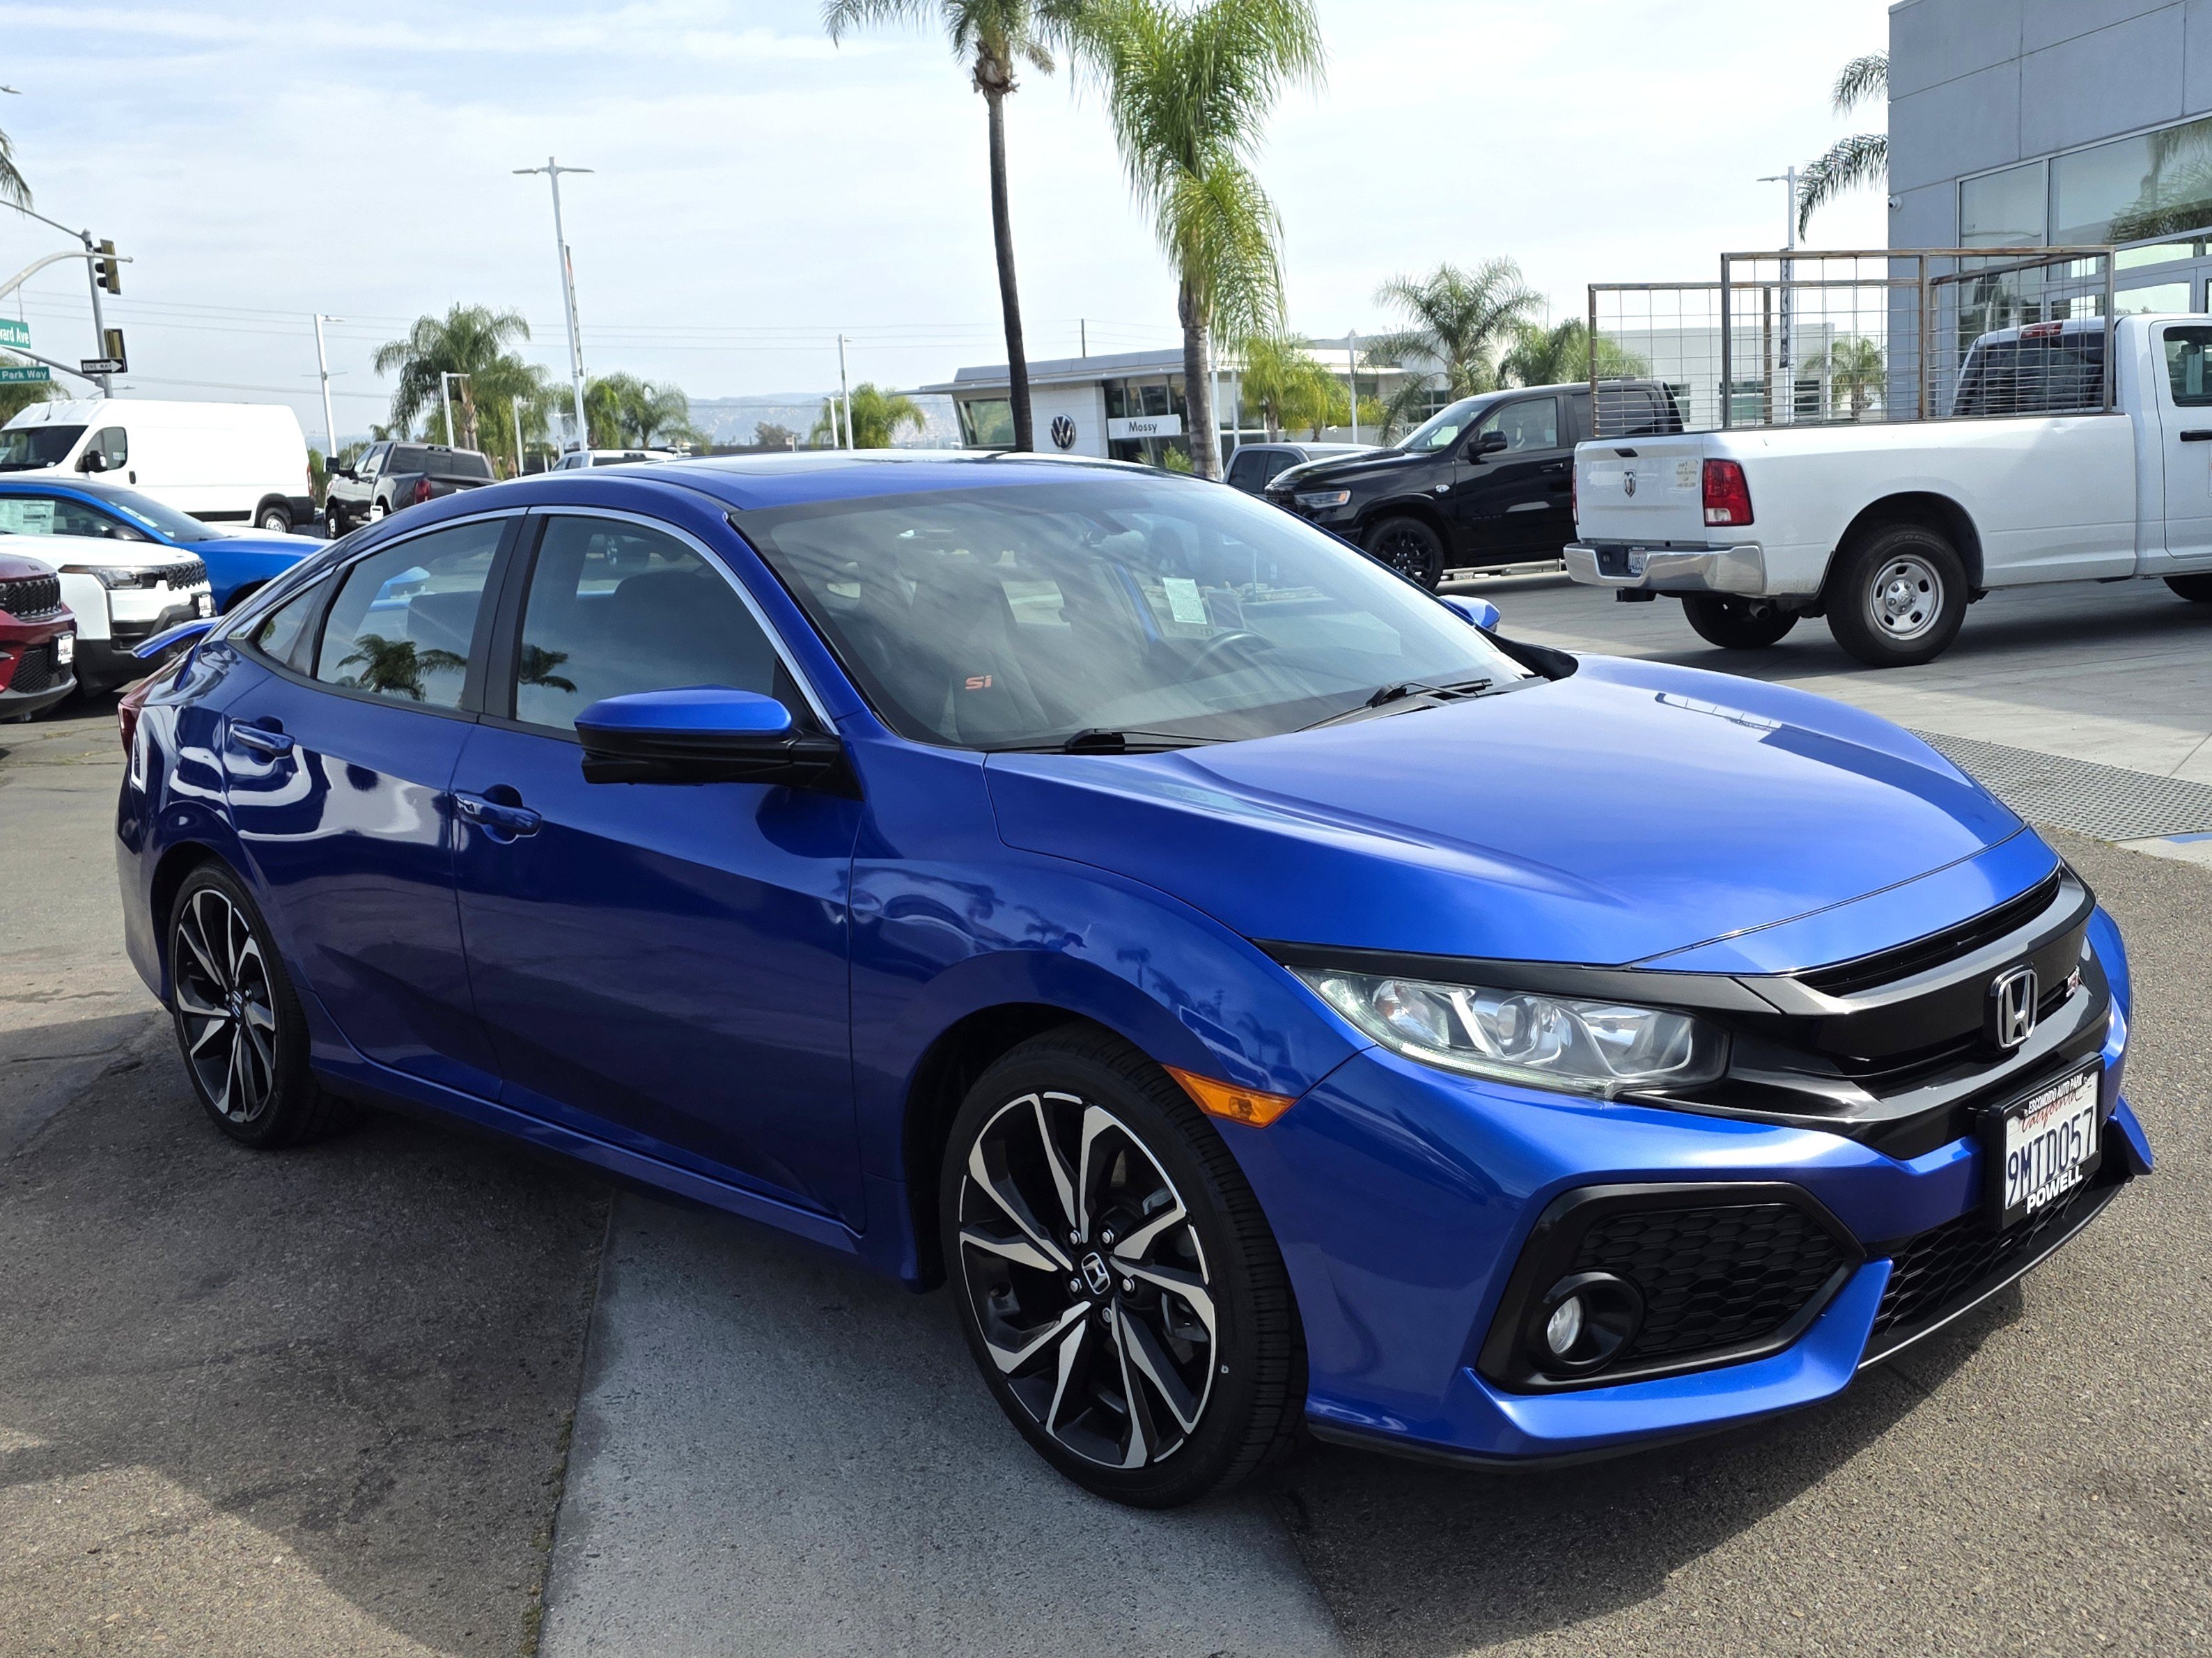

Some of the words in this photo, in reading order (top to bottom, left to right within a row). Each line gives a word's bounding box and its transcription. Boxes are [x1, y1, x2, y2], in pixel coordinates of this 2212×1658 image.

[16, 327, 29, 345] Ave
[1, 370, 24, 380] Park
[27, 369, 47, 380] Way
[1128, 421, 1158, 434] Mossy
[2057, 1079, 2070, 1100] AUTO
[2069, 1072, 2084, 1093] PARK
[2007, 1104, 2094, 1208] 9MTD057
[2026, 1164, 2083, 1214] POWELL
